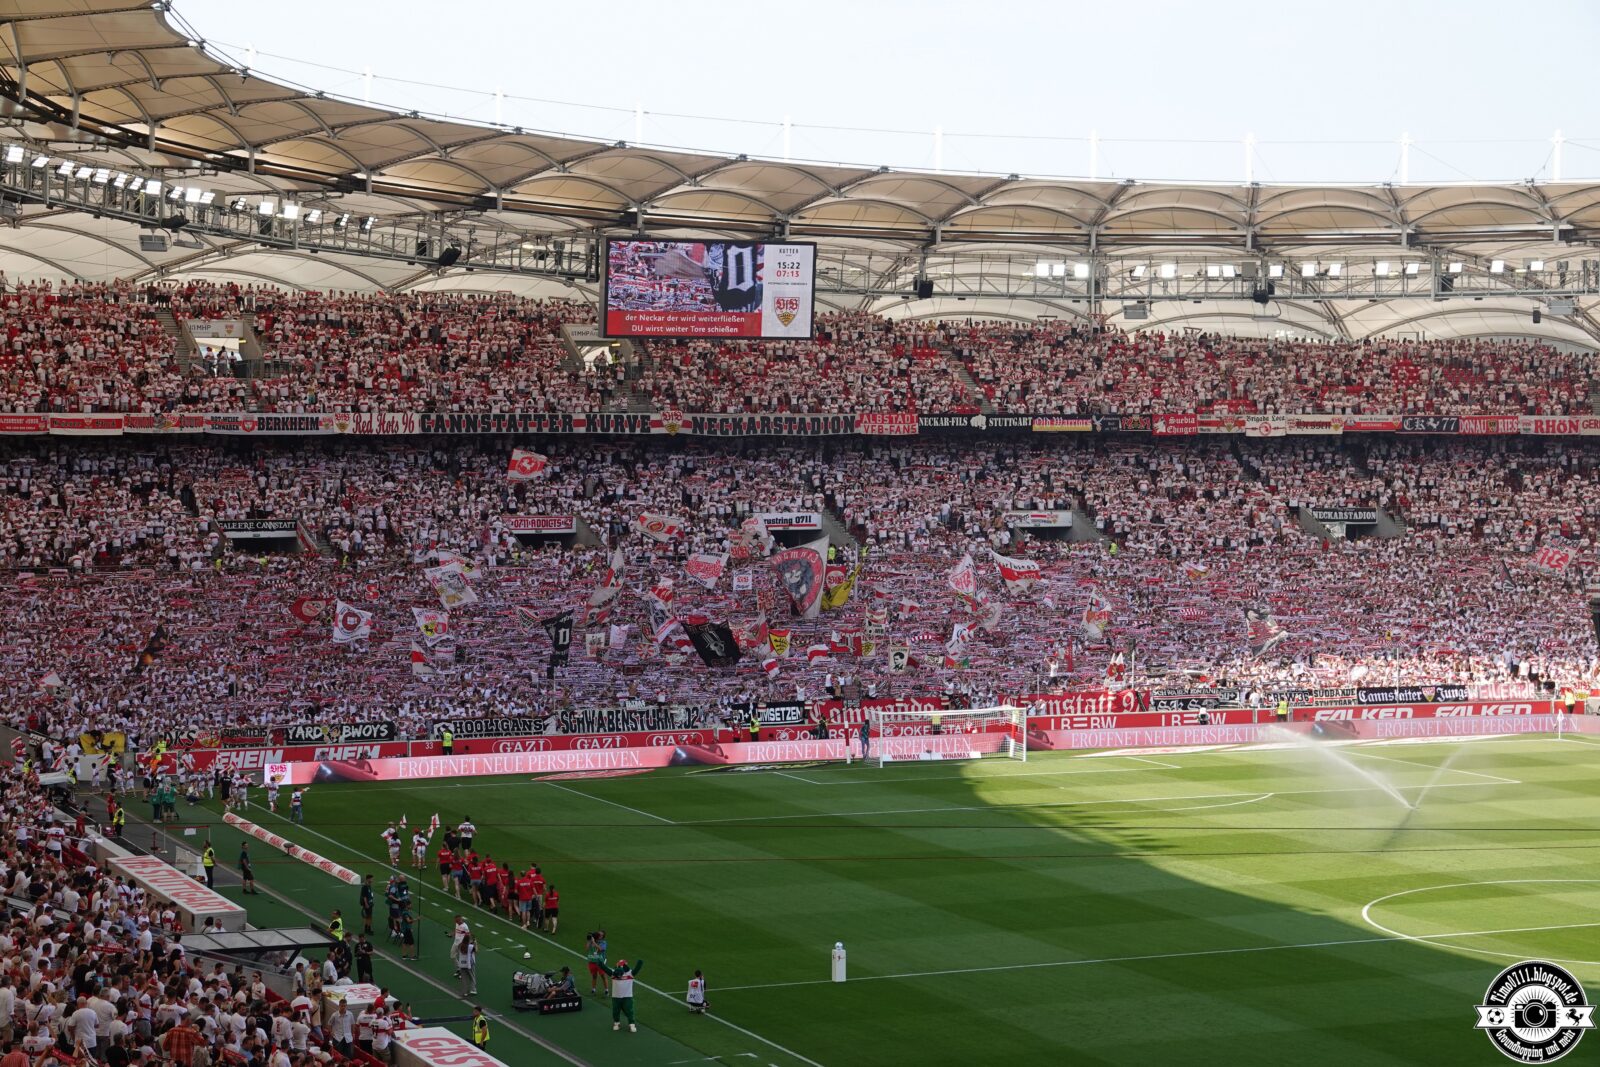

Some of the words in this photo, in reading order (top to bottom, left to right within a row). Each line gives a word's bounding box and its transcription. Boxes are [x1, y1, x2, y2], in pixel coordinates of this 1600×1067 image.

[777, 262, 801, 270] 15:22
[776, 270, 800, 278] 07:13
[640, 314, 665, 322] Neckar
[631, 324, 643, 332] DU
[645, 325, 664, 333] wirst
[665, 325, 689, 333] weiter
[691, 325, 706, 333] Tore
[707, 325, 739, 333] schießen
[257, 416, 320, 431] BERKHEIM
[352, 413, 373, 434] Red
[374, 413, 400, 434] Hots
[401, 413, 415, 433] 96
[420, 413, 574, 433] CANNSTATTER
[585, 413, 651, 433] KURVE
[691, 415, 856, 435] NECKARSTADION
[862, 414, 919, 424] ALBSTADT
[918, 416, 968, 427] NECKAR-FILS
[988, 416, 1033, 427] STUTTGART
[1034, 416, 1051, 428] Old
[1052, 416, 1092, 428] Warriors
[1168, 416, 1195, 425] Suebia
[1441, 416, 1458, 431] 77
[1459, 419, 1487, 434] DONAU
[1500, 418, 1519, 433] RIES
[863, 424, 917, 434] VFB-FANS
[794, 515, 812, 524] 0711
[1312, 511, 1376, 520] NECKARSTADION
[256, 521, 296, 530] CANNSTATT
[1437, 686, 1468, 702] Jungs
[1434, 704, 1533, 718] FALKEN
[453, 719, 544, 733] HOOLIGANS
[560, 706, 675, 734] SCHWABENSTURM
[1445, 717, 1479, 735] NEUE
[288, 725, 323, 740] YARD
[342, 724, 389, 739] BWOYS
[1143, 726, 1180, 745] NEUE
[425, 741, 434, 750] 33
[746, 739, 821, 762] ERÖFFNET
[941, 751, 971, 759] WINAMAX
[399, 755, 479, 779] ERÖFFNET
[482, 754, 525, 774] NEUE
[528, 749, 644, 773] PERSPEKTIVEN.
[134, 869, 239, 912] STUTTGART
